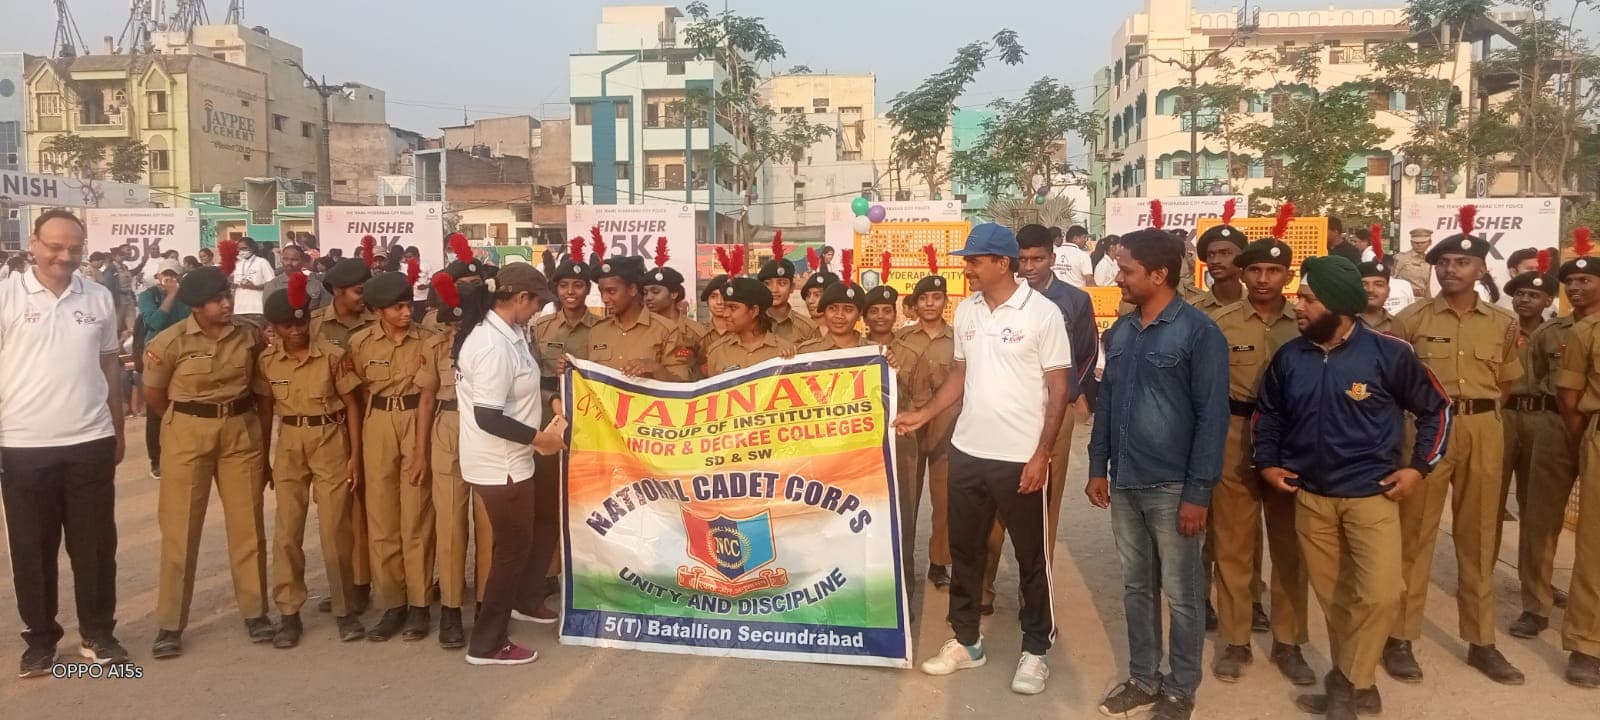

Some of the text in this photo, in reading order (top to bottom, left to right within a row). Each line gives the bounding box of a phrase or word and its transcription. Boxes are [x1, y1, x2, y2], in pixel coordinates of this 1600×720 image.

[202, 108, 255, 133] JAYPEE
[213, 126, 255, 142] CEMENT
[3, 174, 58, 198] NISH
[111, 223, 175, 236] FINISHER
[347, 222, 414, 234] FINISHER
[597, 220, 667, 233] FINISHER
[612, 235, 653, 260] 5K
[942, 271, 964, 279] CITY
[614, 369, 867, 430] JAHNAVI
[637, 401, 872, 440] GROUP OF INSTITUTIONS
[682, 440, 693, 455] &
[700, 430, 771, 454] DEGREE
[777, 416, 875, 442] COLLEGES
[705, 449, 772, 467] SD & SW
[692, 472, 780, 501] CADET
[785, 476, 872, 534] CORPS
[715, 537, 741, 558] NCC
[618, 566, 847, 616] UNITY AND DISCIPLINE
[604, 616, 864, 648] 5(T) Batallion Secundrabad
